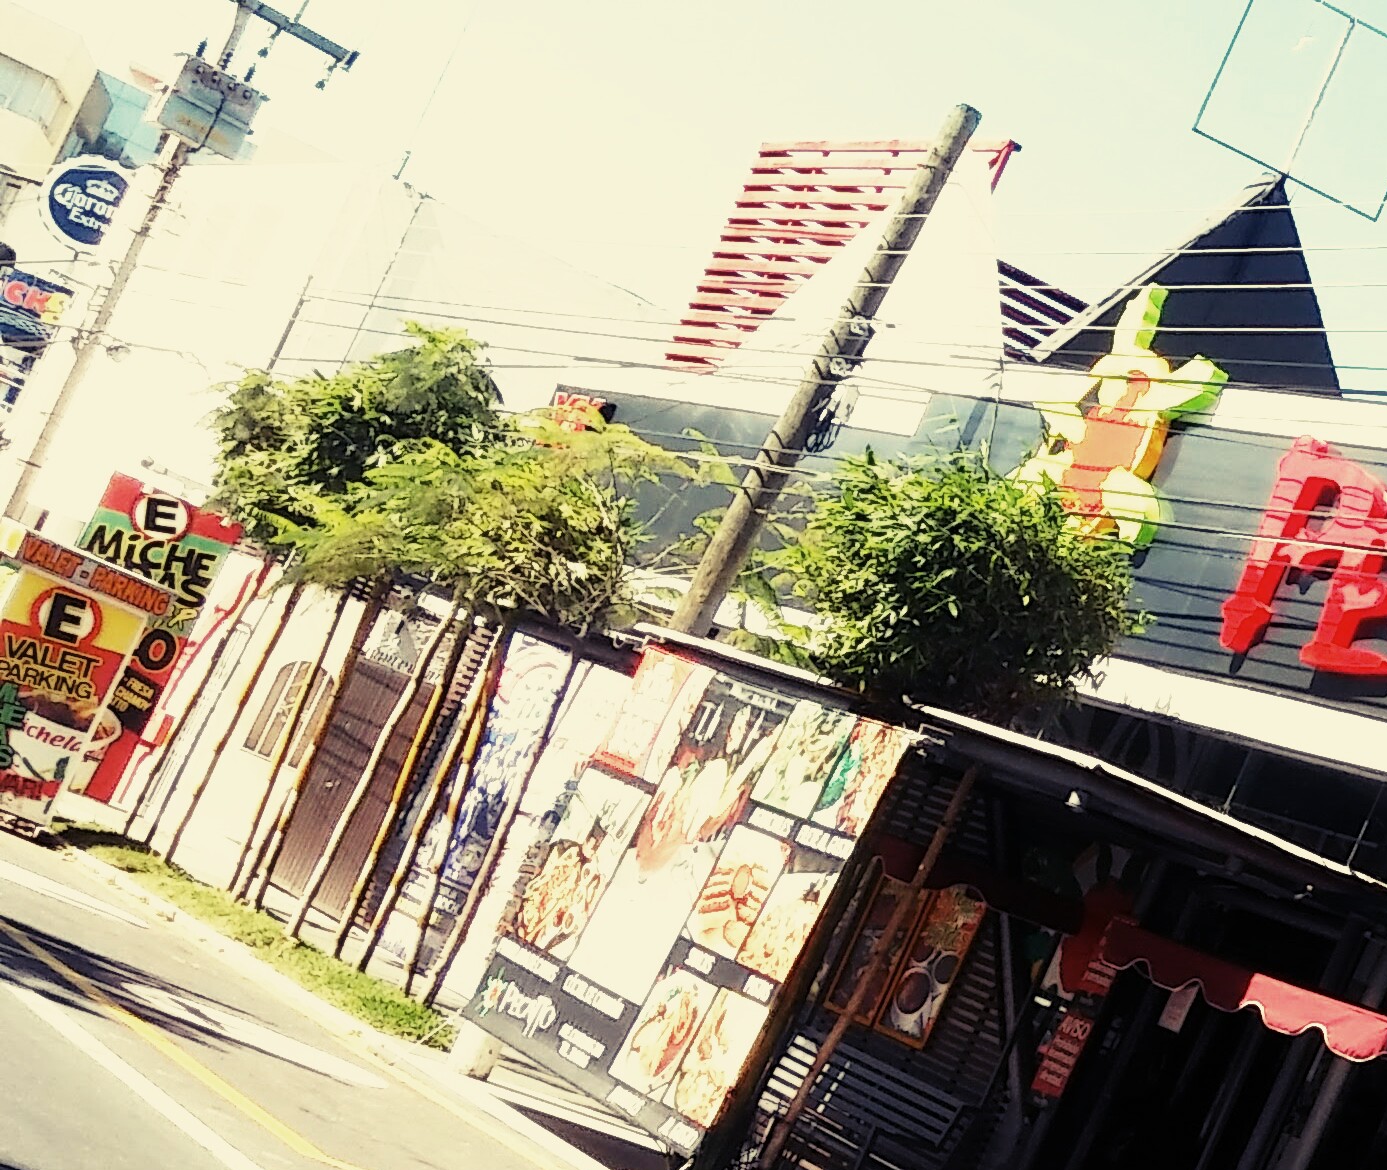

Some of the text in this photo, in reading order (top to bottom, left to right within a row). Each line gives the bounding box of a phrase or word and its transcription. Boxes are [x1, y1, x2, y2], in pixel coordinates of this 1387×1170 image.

[23, 536, 83, 578] VALET
[90, 564, 170, 616] PARKING
[43, 592, 88, 645] E
[6, 635, 101, 679] VALET
